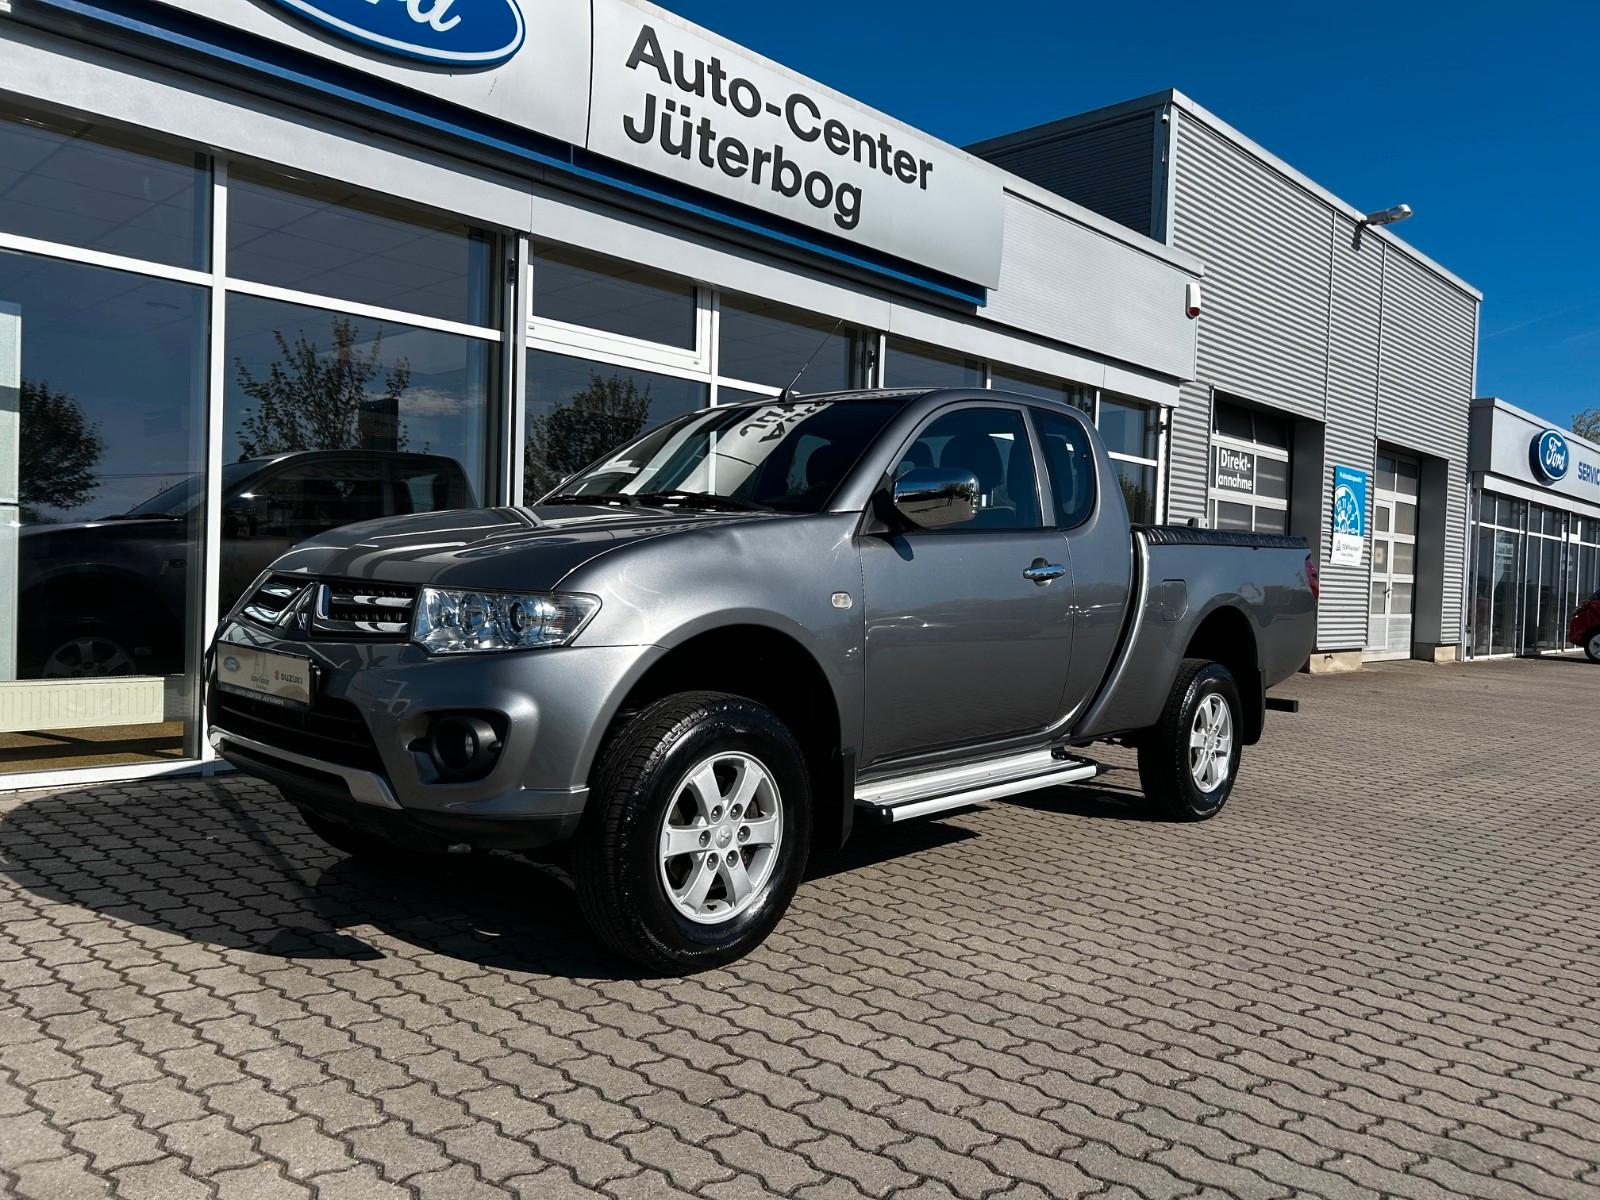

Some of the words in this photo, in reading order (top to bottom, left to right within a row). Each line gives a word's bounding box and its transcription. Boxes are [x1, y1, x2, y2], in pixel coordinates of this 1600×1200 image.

[625, 24, 933, 190] Auto-Center
[623, 93, 862, 230] Jüterbog
[1220, 449, 1251, 471] Direkt-
[1546, 436, 1566, 471] Ford
[1218, 473, 1252, 490] annahme
[280, 672, 303, 685] SUZUKI
